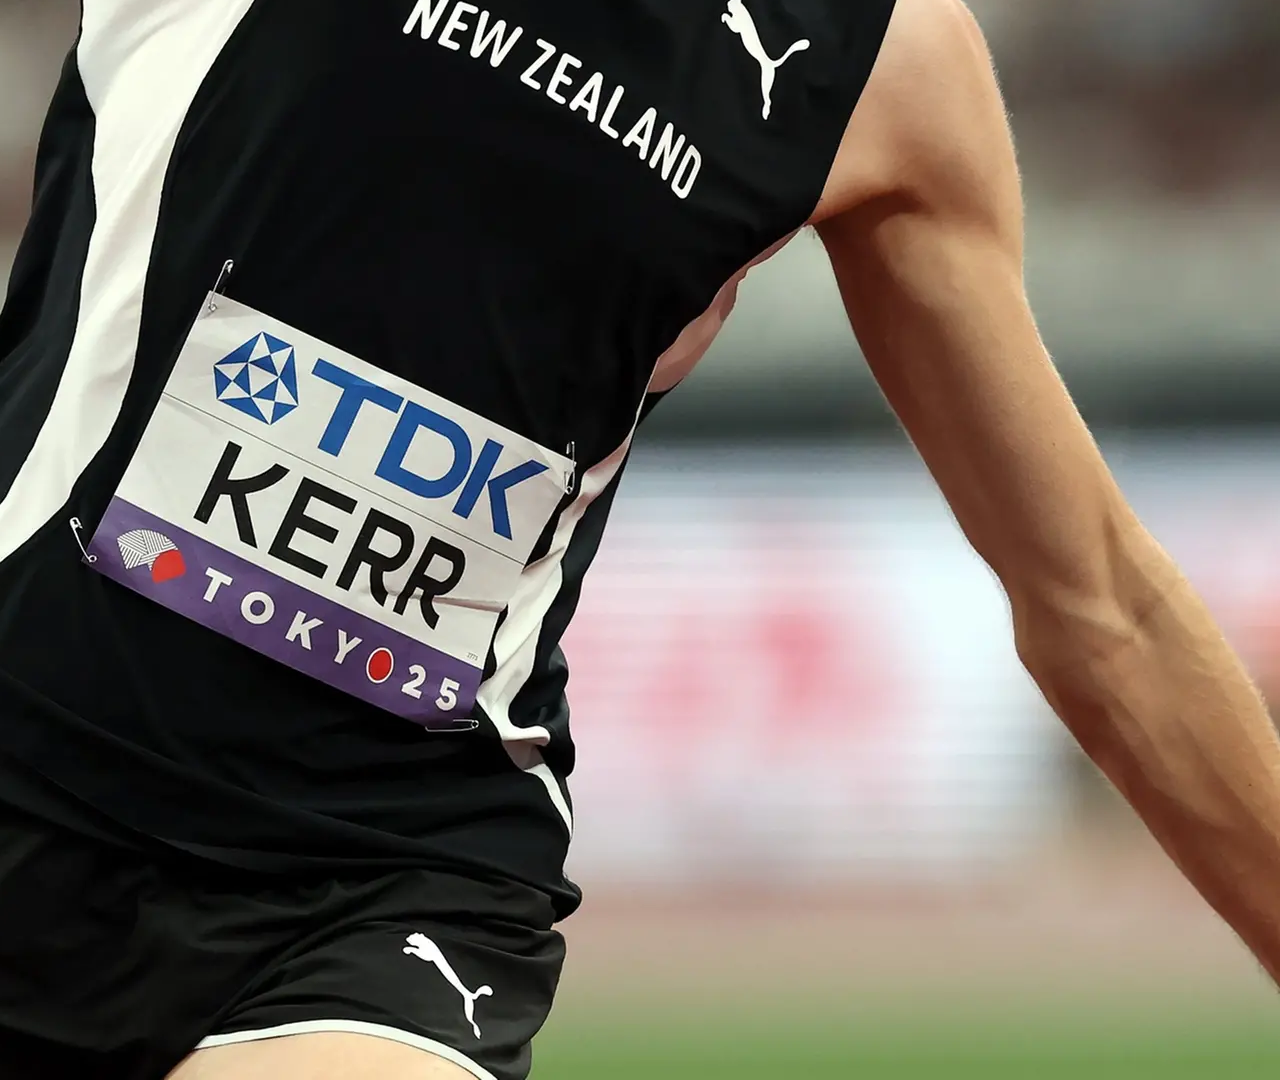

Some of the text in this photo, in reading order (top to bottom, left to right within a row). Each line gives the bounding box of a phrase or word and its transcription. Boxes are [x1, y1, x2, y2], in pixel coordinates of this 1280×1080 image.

[520, 38, 702, 199] ZEALAND
[193, 441, 466, 630] KERR
[311, 358, 549, 540] TDK
